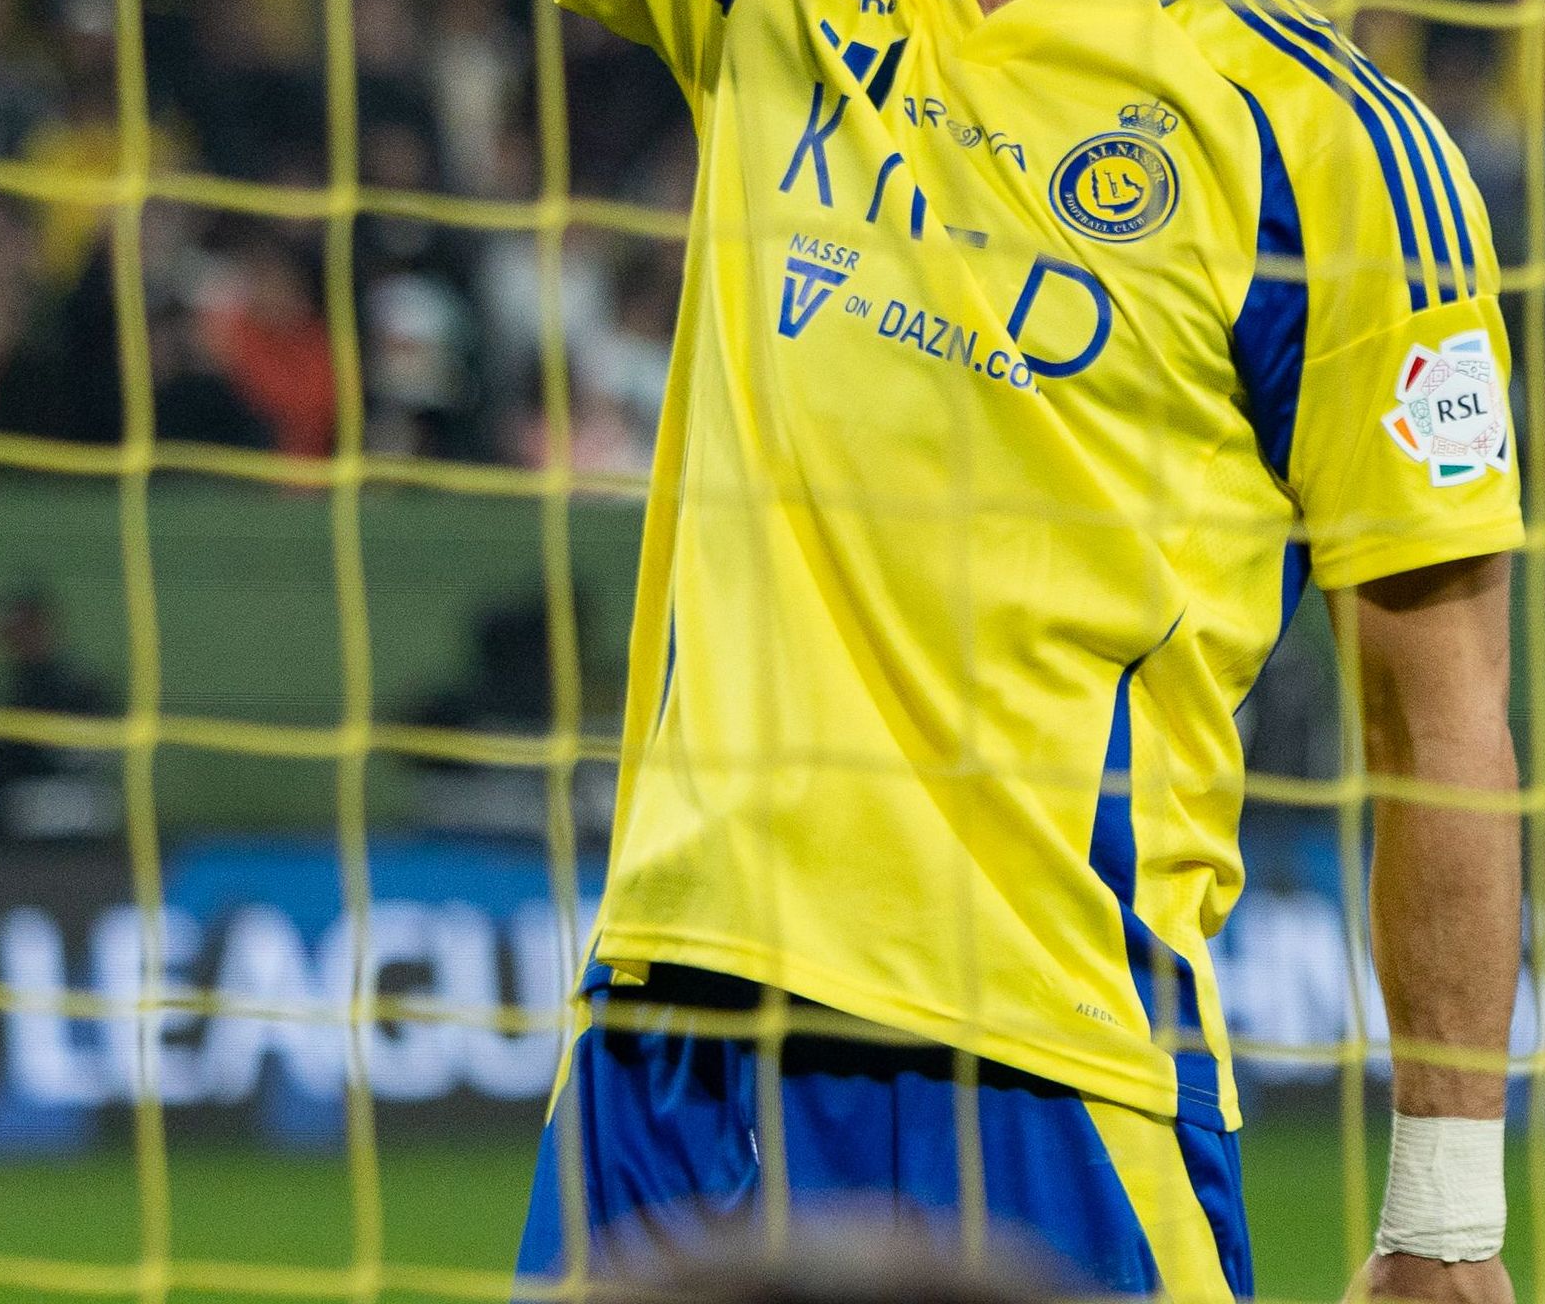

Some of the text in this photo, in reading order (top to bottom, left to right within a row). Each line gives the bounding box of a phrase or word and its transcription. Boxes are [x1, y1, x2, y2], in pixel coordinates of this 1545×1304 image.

[789, 232, 860, 271] NASSR
[845, 295, 873, 318] ON
[1438, 393, 1488, 423] RSL
[0, 900, 594, 1102] LEAGU
